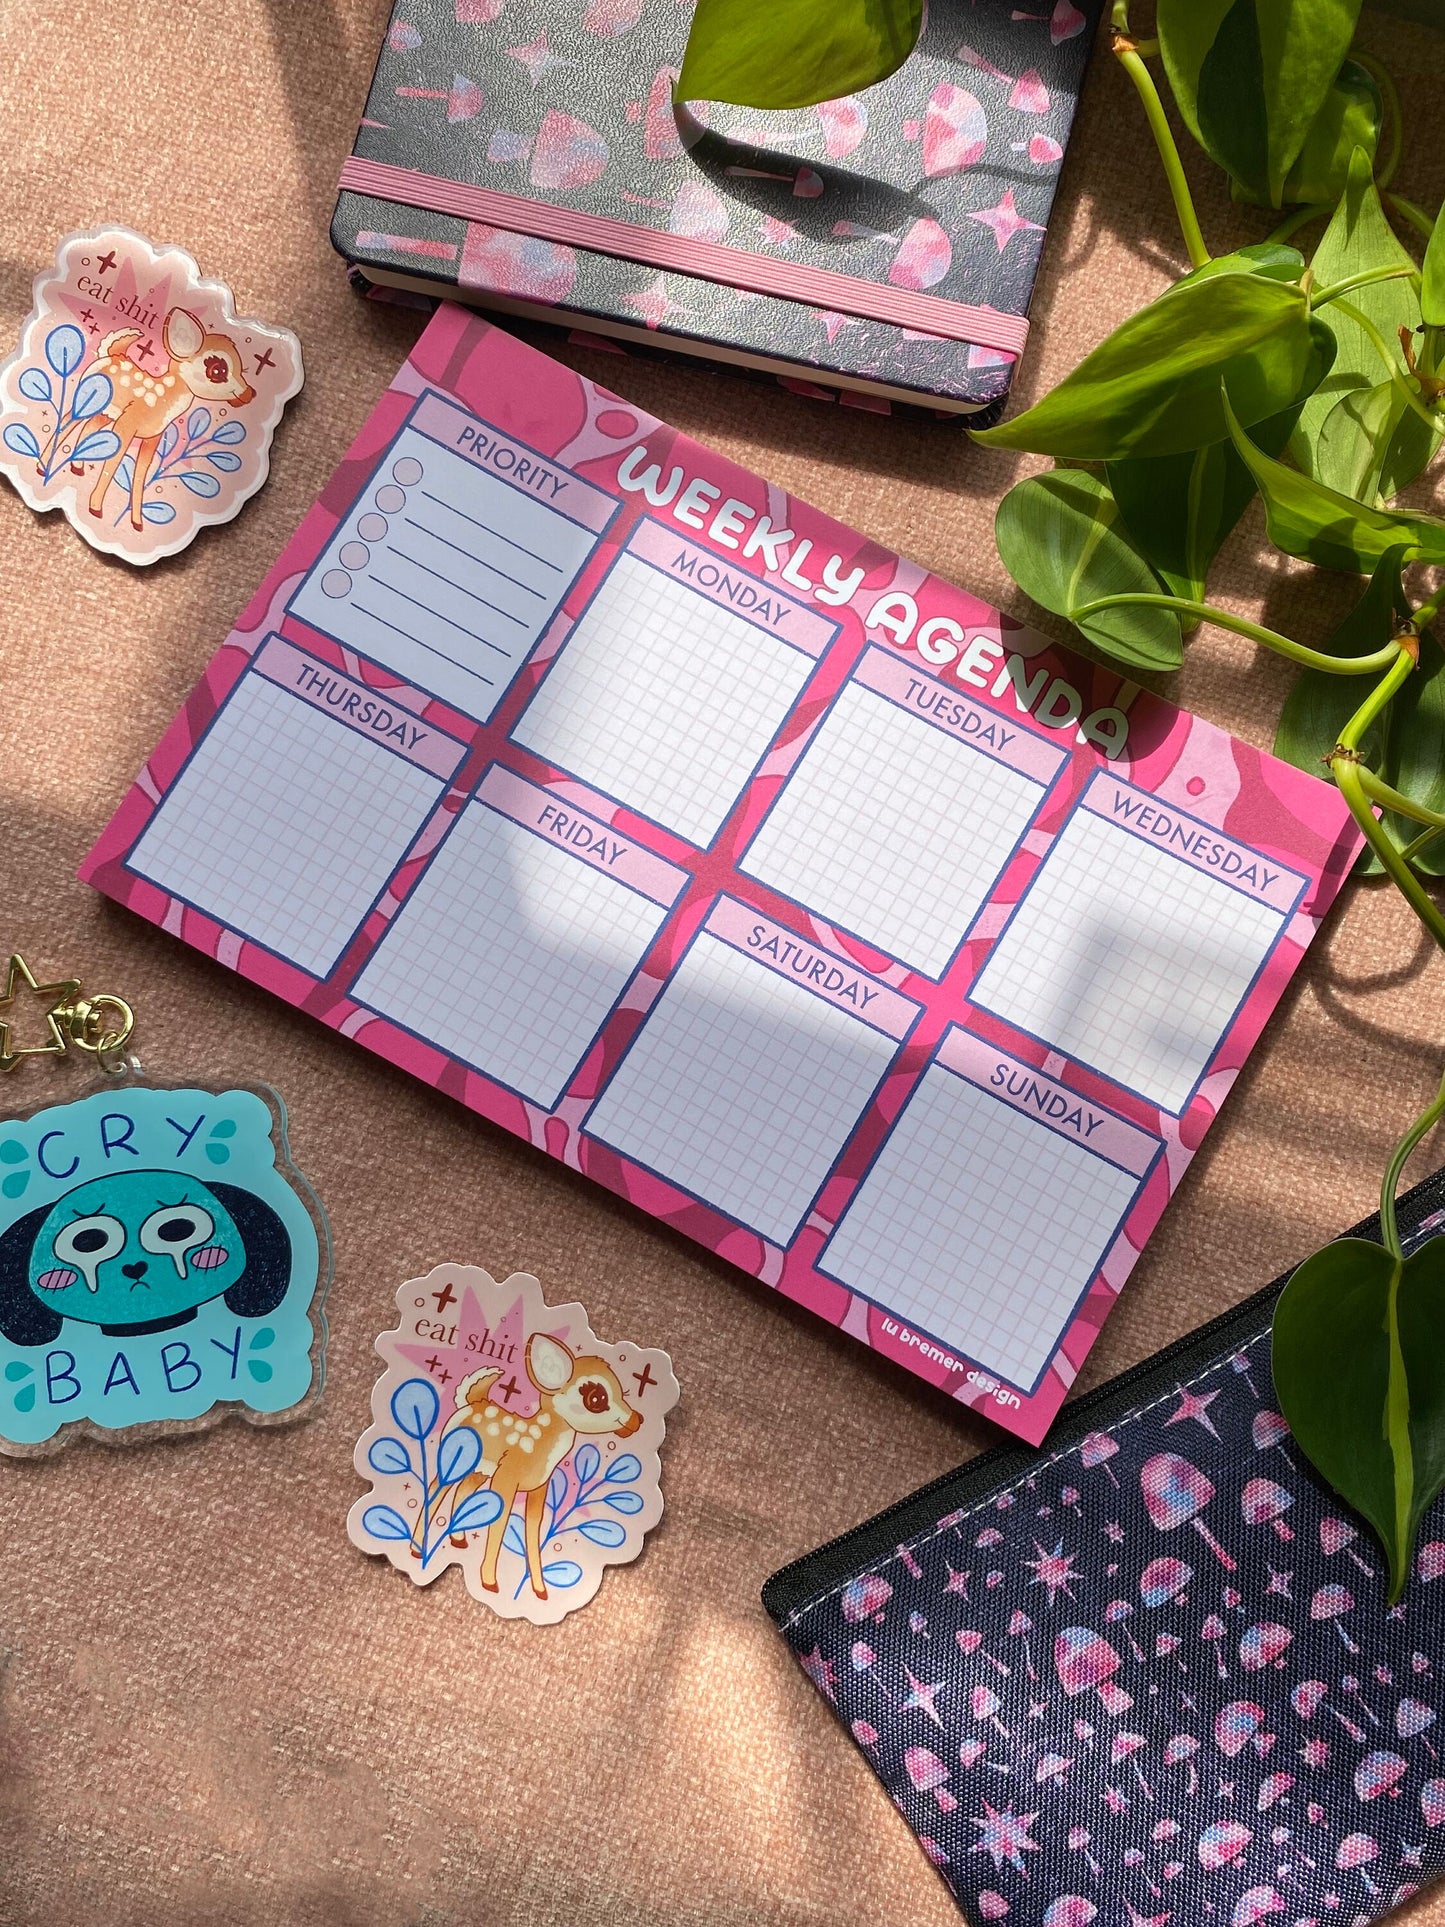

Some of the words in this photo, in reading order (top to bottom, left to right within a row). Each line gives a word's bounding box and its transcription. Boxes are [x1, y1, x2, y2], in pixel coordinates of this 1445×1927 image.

[77, 275, 114, 303] eat
[115, 295, 159, 329] shit
[456, 426, 569, 499] PRIORITY
[617, 446, 866, 606] WEEKLY
[865, 591, 1129, 761] AGENDA
[671, 549, 791, 626] MONDAY
[294, 663, 429, 751] THURSDAY
[904, 678, 1016, 752] TUESDAY
[537, 805, 628, 866] FRIDAY
[1112, 790, 1280, 892] WEDNESDAY
[747, 925, 879, 1010] SATURDAY
[990, 1063, 1104, 1138] SUNDAY
[38, 1113, 206, 1178] CRY
[46, 1326, 242, 1404] BABY
[415, 1318, 460, 1345] eat
[465, 1328, 518, 1363] shit
[899, 1328, 964, 1373] bremer
[966, 1370, 1021, 1410] design
